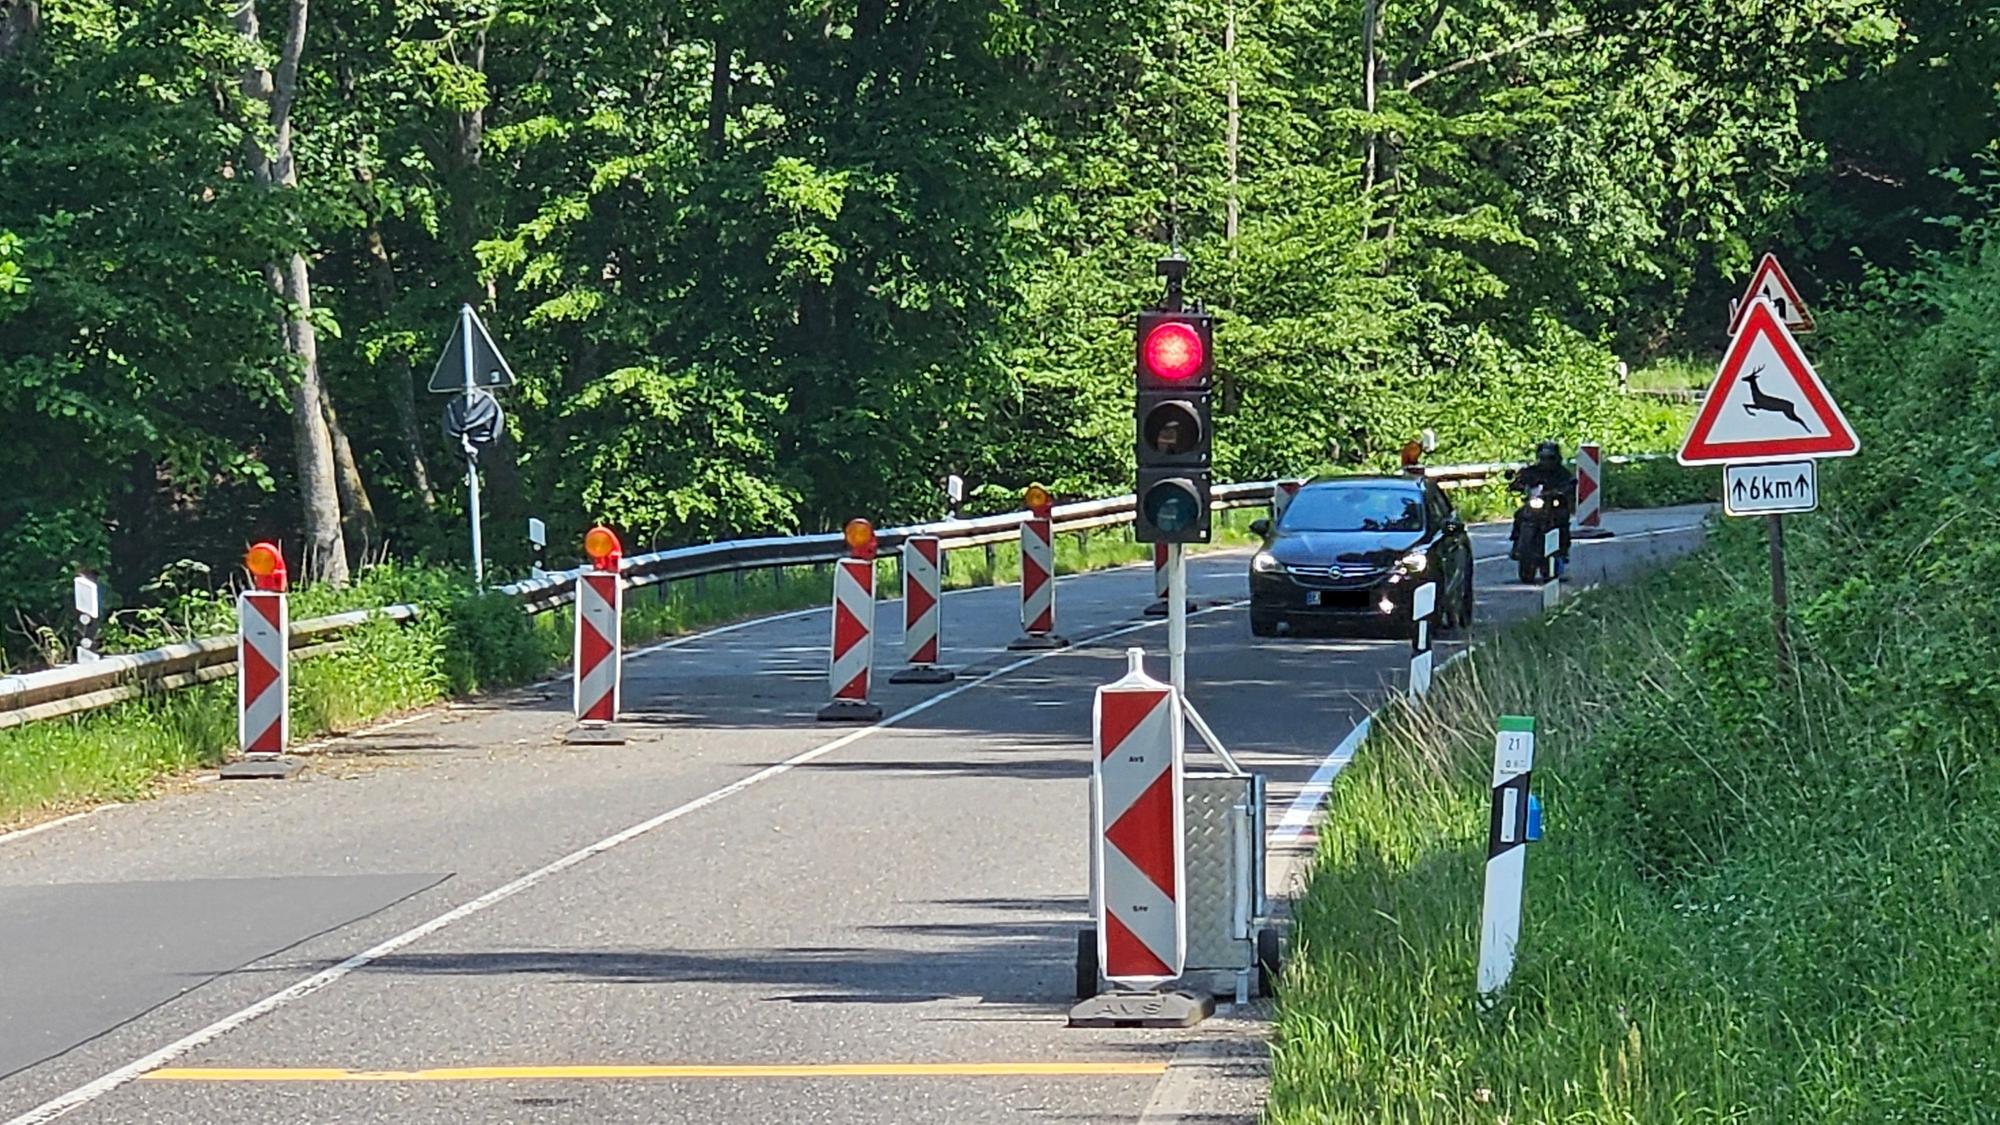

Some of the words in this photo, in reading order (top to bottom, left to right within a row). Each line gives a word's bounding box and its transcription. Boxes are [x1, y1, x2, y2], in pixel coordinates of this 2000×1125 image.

[1750, 475, 1793, 500] 6km
[1508, 737, 1520, 751] 21
[1094, 1002, 1162, 1015] AVS
